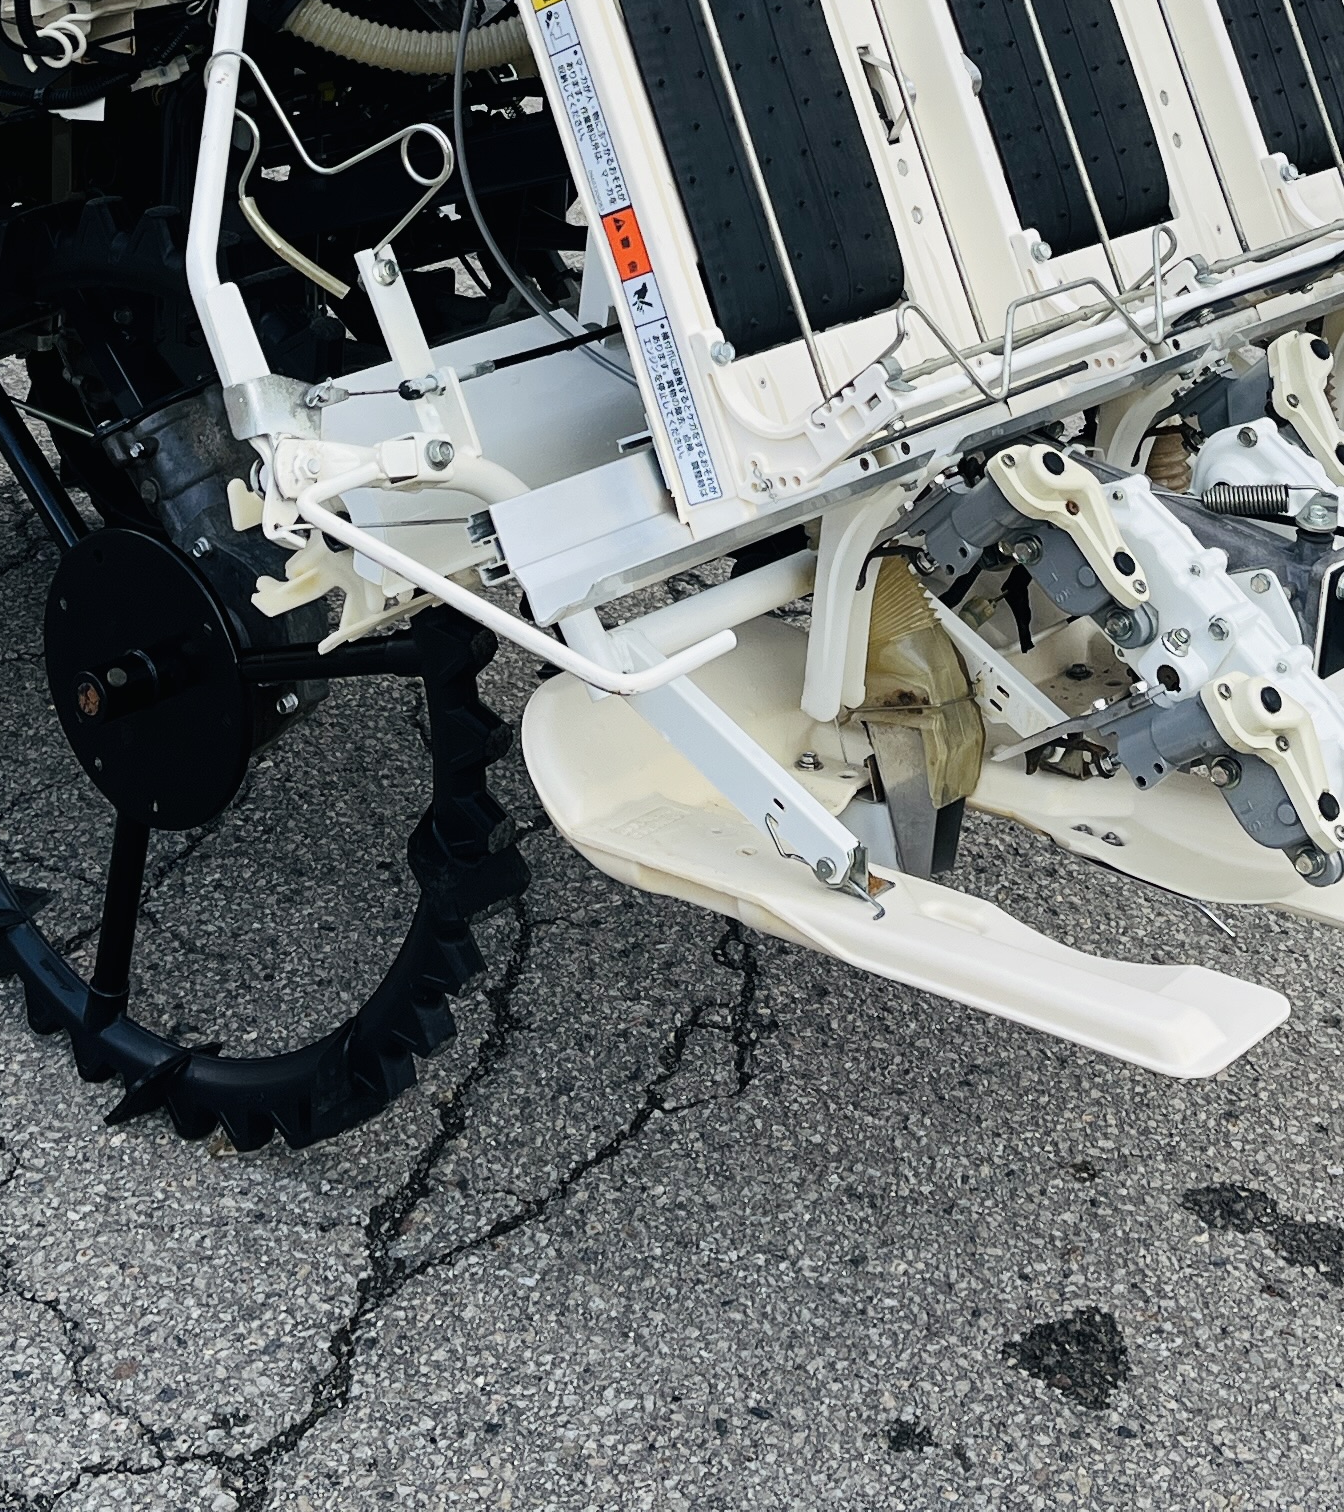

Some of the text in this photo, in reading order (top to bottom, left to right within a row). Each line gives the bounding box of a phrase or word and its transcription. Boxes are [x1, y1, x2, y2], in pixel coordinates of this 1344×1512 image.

[642, 336, 687, 460] エンジンを停止してください。
